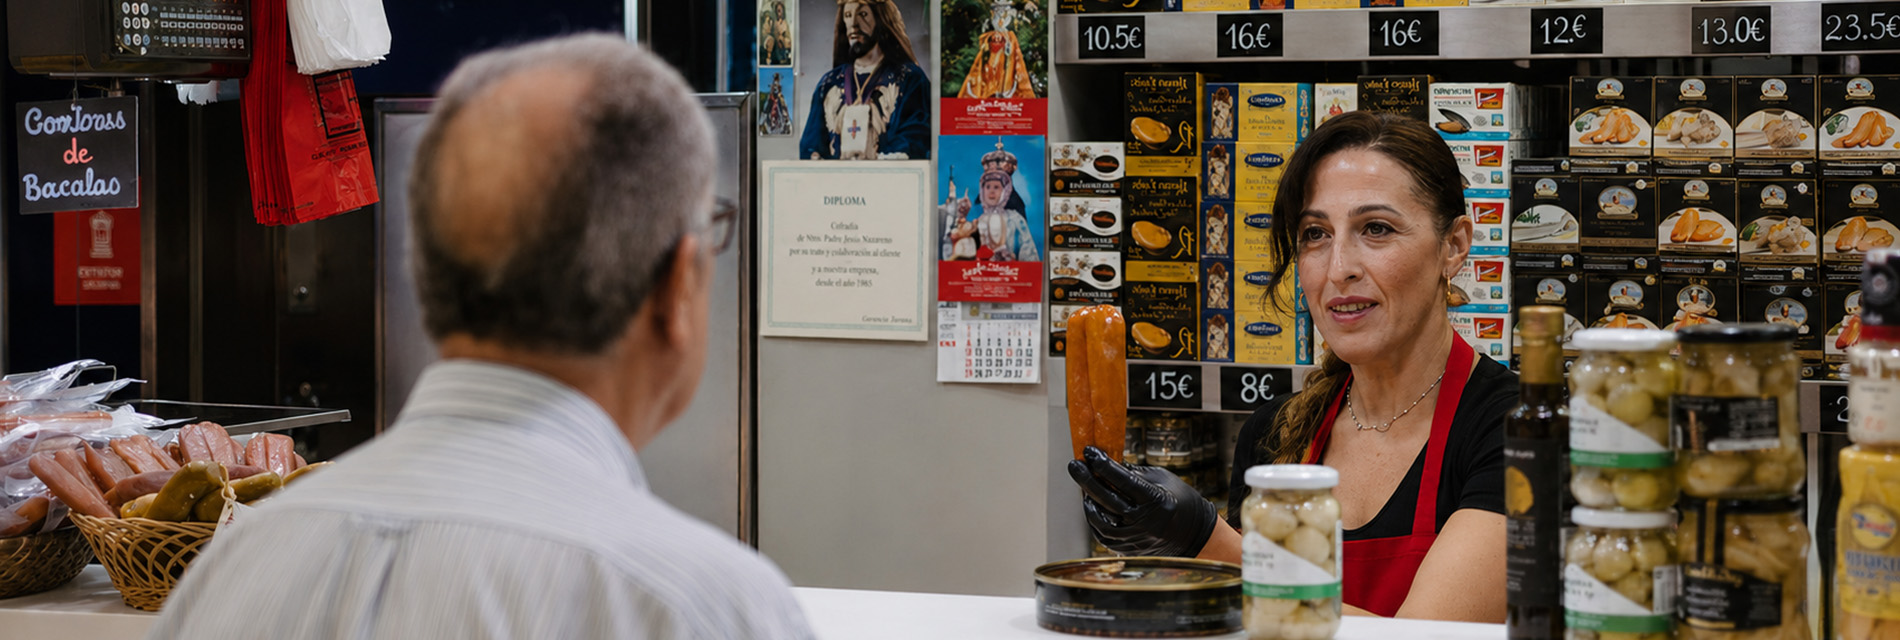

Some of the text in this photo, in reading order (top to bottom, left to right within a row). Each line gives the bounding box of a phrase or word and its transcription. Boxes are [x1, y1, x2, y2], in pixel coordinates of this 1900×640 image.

[1084, 24, 1142, 51] 10.5€
[1380, 18, 1422, 47] 16€
[1697, 16, 1766, 46] 13.0€
[1824, 12, 1900, 42] 23.5€
[63, 137, 94, 165] de
[823, 196, 867, 206] DIPLOMA
[789, 248, 800, 257] por
[872, 248, 879, 257] al
[880, 249, 901, 258] cliente
[824, 234, 842, 243] Padre
[862, 235, 893, 244] Nazareno
[815, 278, 834, 288] desde
[835, 278, 842, 288] el
[1145, 371, 1194, 400] 15€
[1240, 372, 1275, 403] 8€
